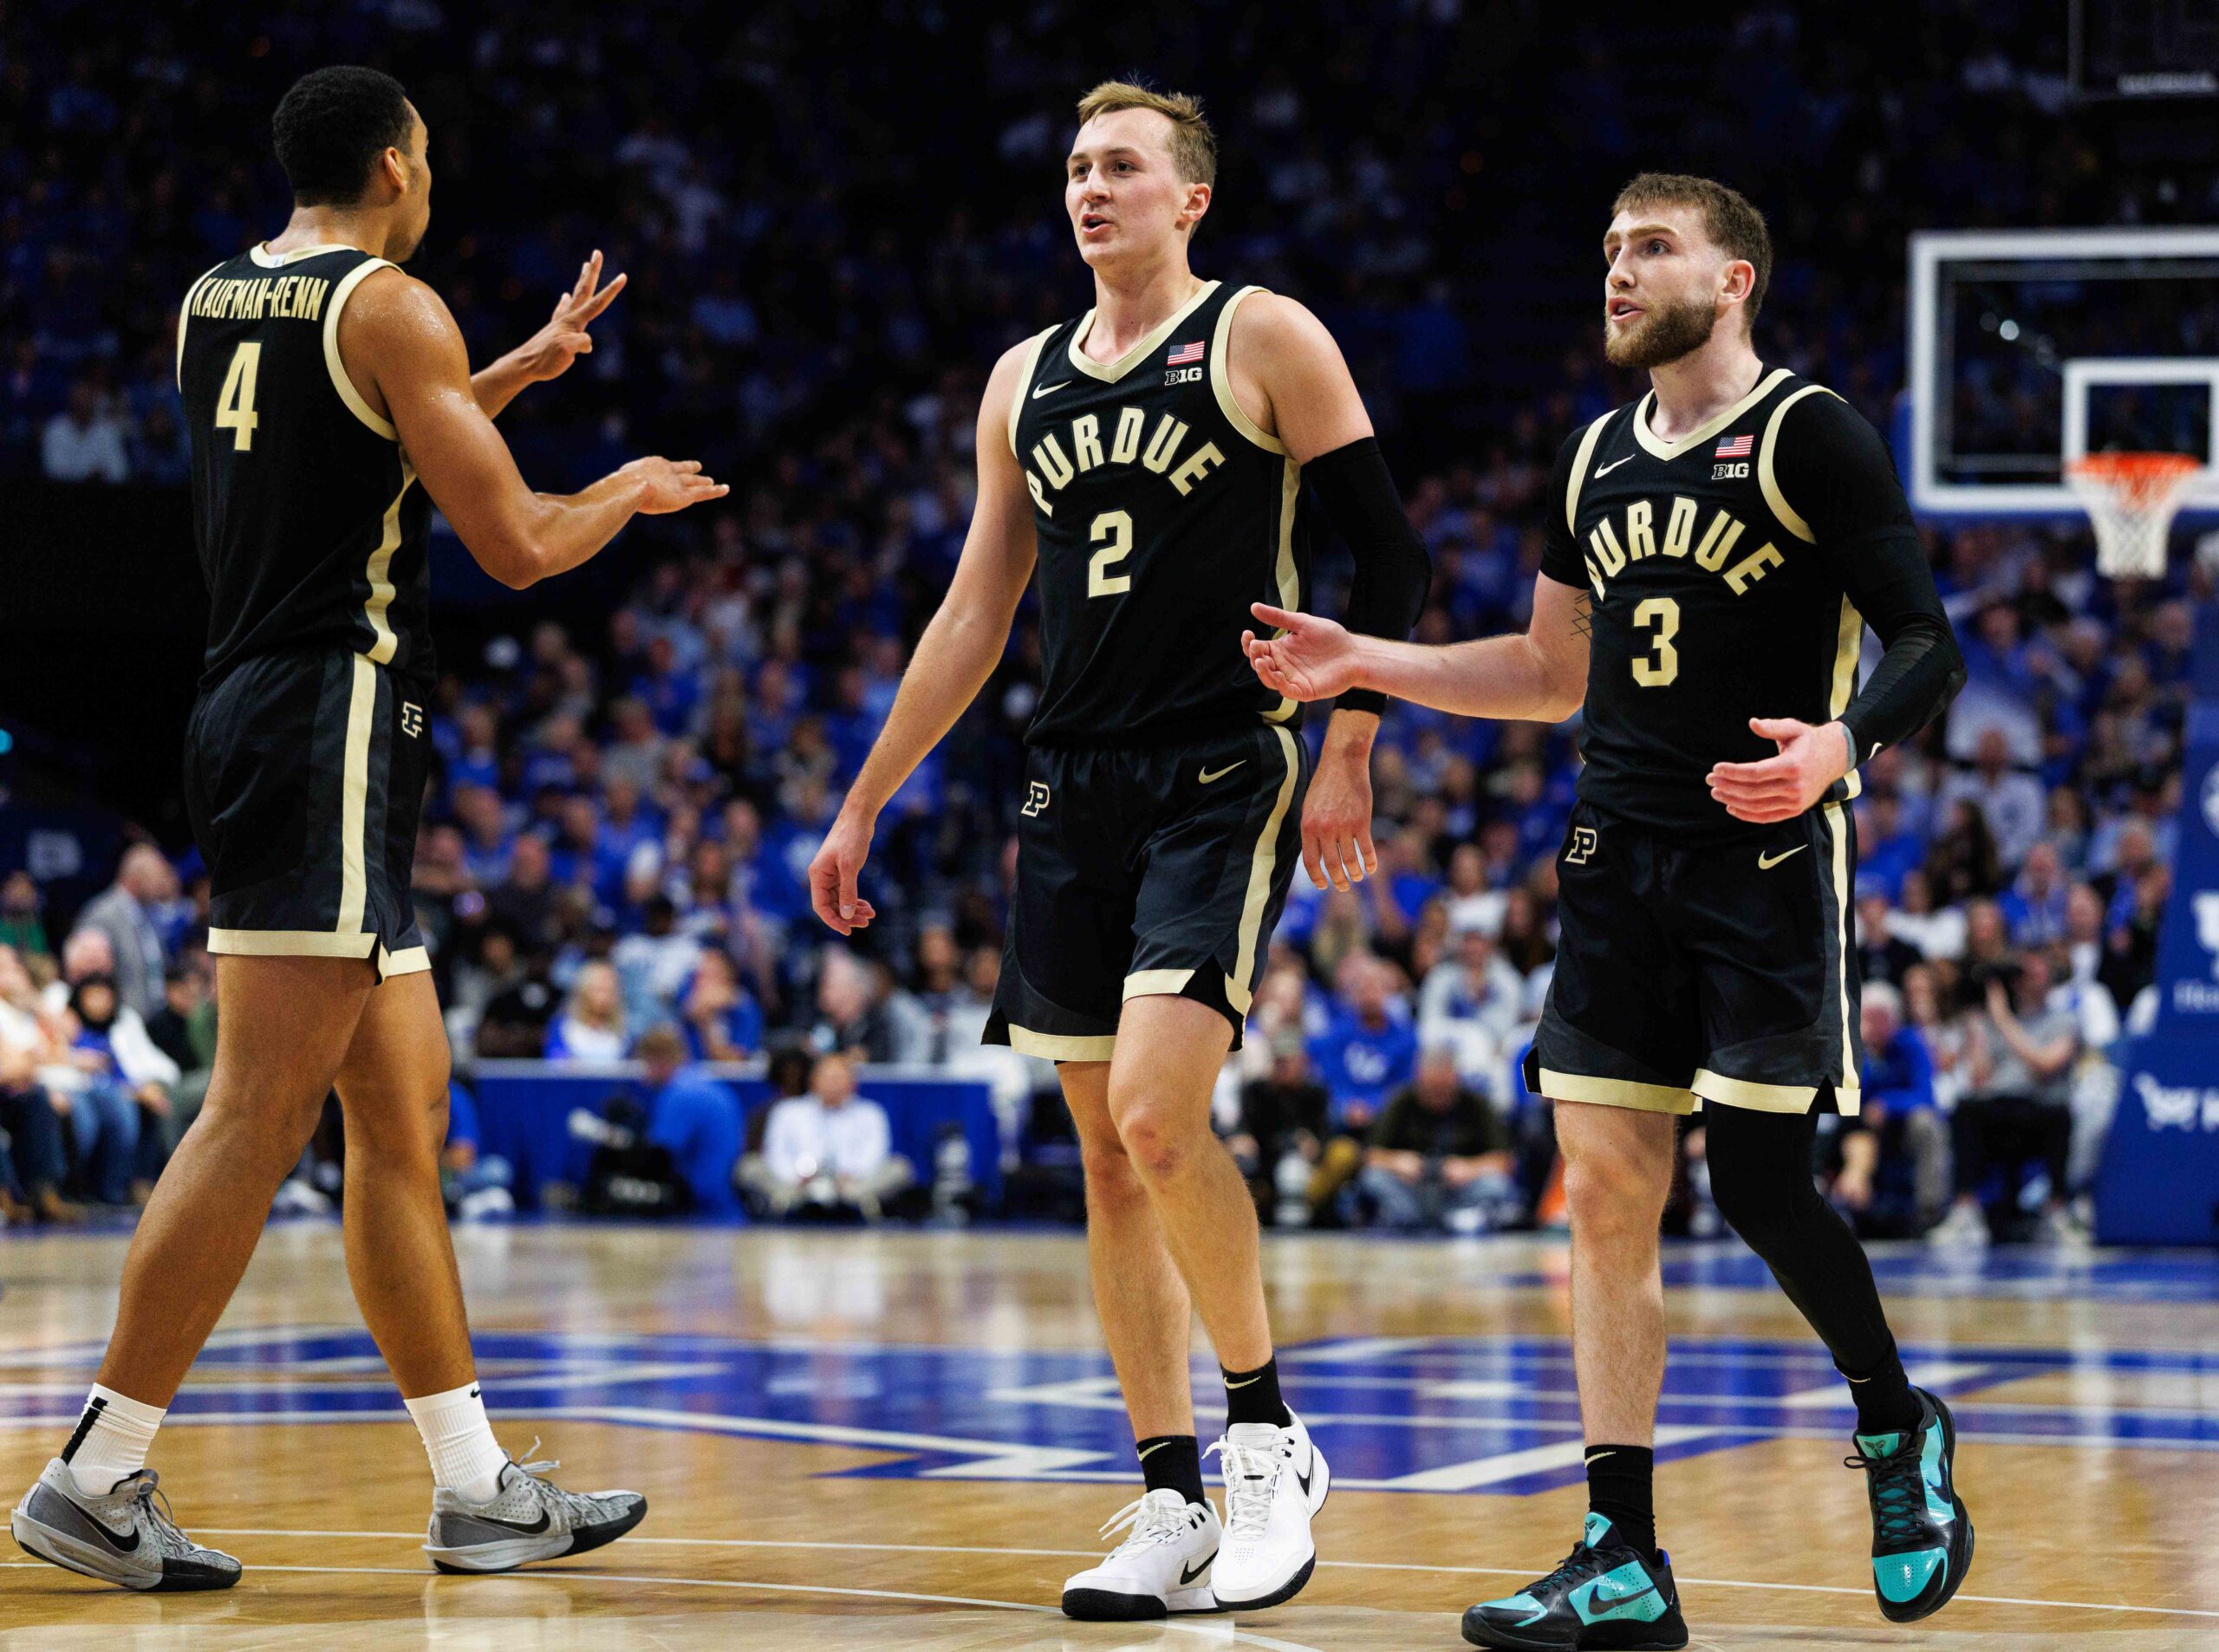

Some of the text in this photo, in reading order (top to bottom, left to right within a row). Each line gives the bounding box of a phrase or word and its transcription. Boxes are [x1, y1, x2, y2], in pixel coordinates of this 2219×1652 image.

[191, 276, 329, 321] KAUFMAN-RENN
[216, 341, 262, 452] 4
[1164, 367, 1203, 386] BIG
[1025, 406, 1227, 518] PURDUE
[1711, 462, 1750, 480] BIG
[1087, 510, 1133, 598] 2
[1631, 597, 1680, 686] 3
